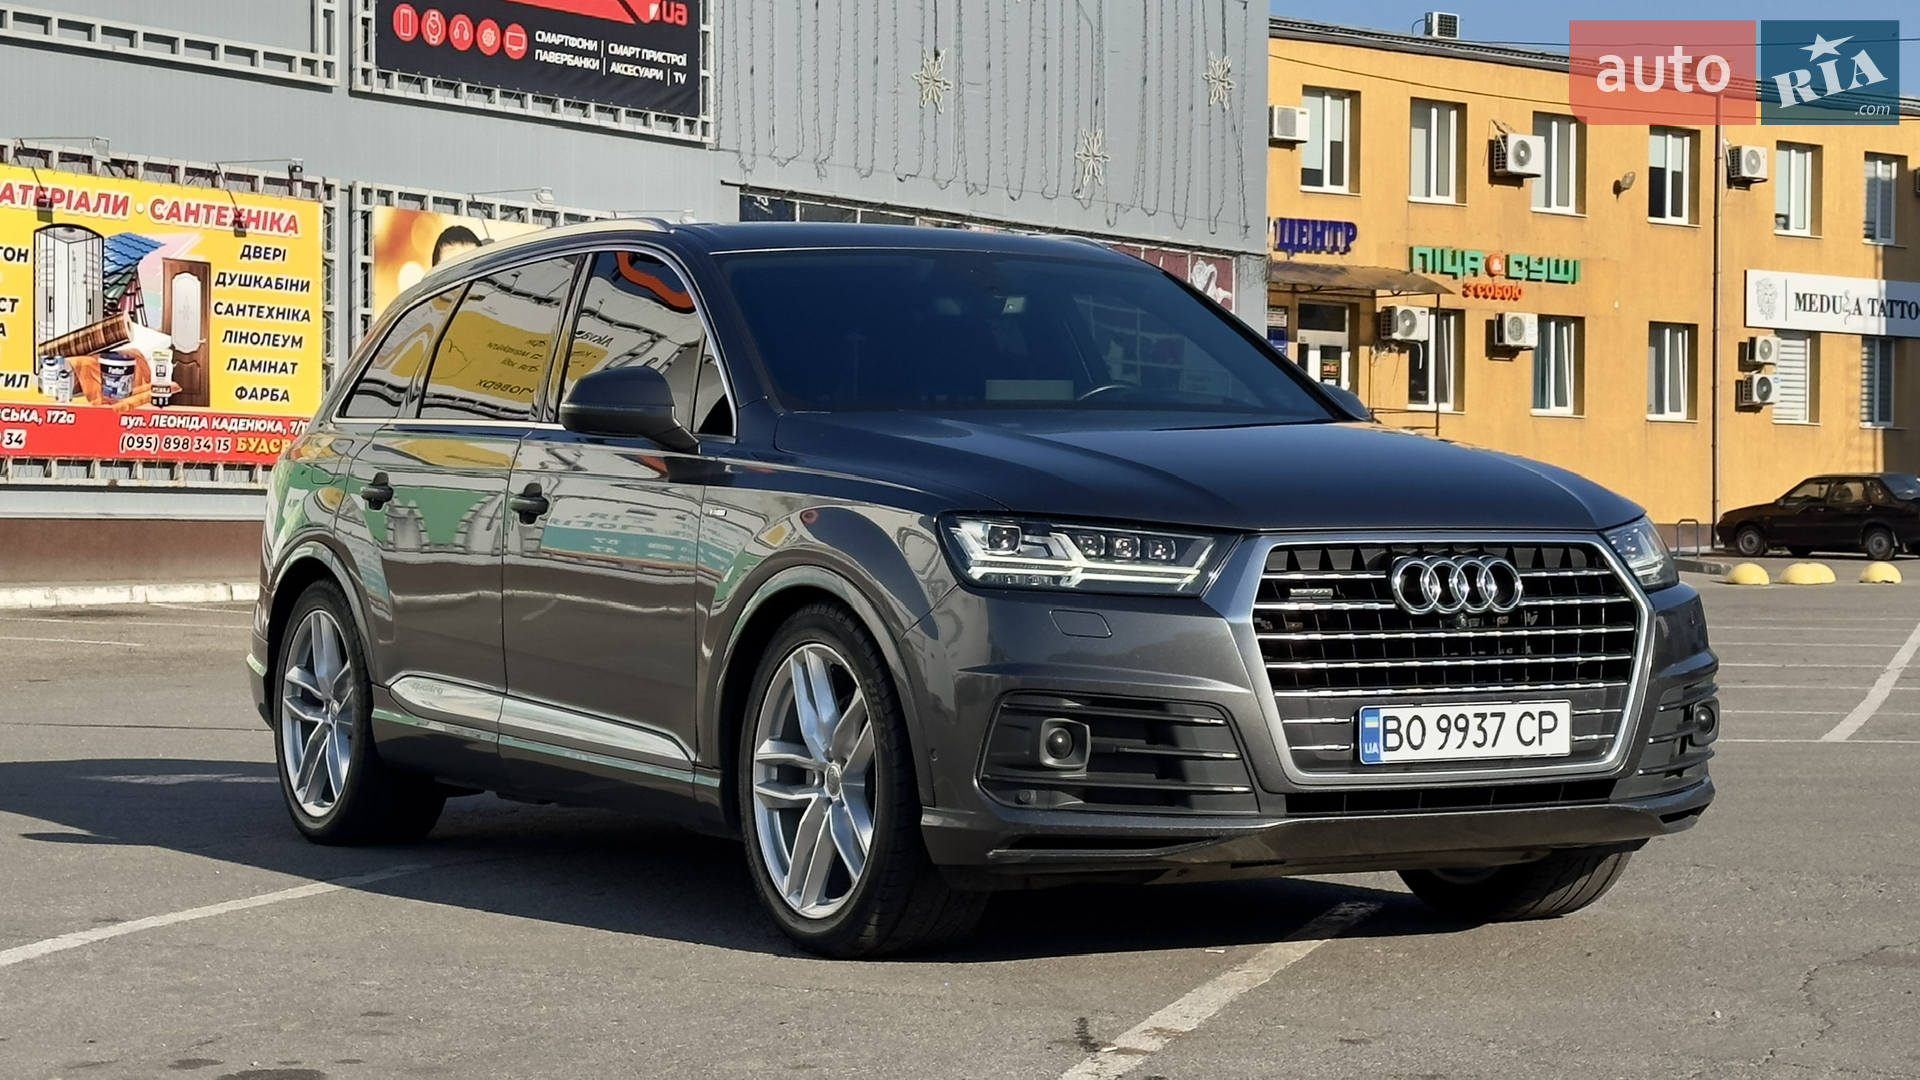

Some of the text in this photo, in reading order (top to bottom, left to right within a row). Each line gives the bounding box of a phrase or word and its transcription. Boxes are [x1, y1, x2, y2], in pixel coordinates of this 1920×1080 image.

[535, 30, 687, 66] СМАРТФОНИ СМАРТ ПРИСТРОЇ
[535, 49, 687, 85] ПАВЕРБАНКИ АКСЕСУАРИ TV
[240, 244, 286, 261] ДВЕРІ
[1409, 246, 1483, 280] ПІЦА
[215, 272, 310, 293] ДУШКАБІНИ
[214, 302, 310, 322] САНТЕХНІКА
[222, 330, 303, 348] ЛІНОЛЕУМ
[226, 358, 298, 374] ЛАМІНАТ
[235, 385, 290, 402] ФАРБА
[120, 415, 146, 430] вул.
[149, 415, 209, 431] ЛЕОНІДА
[211, 417, 287, 435] КАДЕНЮКА,
[5, 432, 24, 445] 34
[120, 435, 158, 452] (095)
[163, 437, 190, 450] 898
[193, 439, 211, 451] 34
[217, 439, 230, 451] 15
[1382, 710, 1558, 752] BO 9937 CP
[1364, 743, 1379, 754] UA
